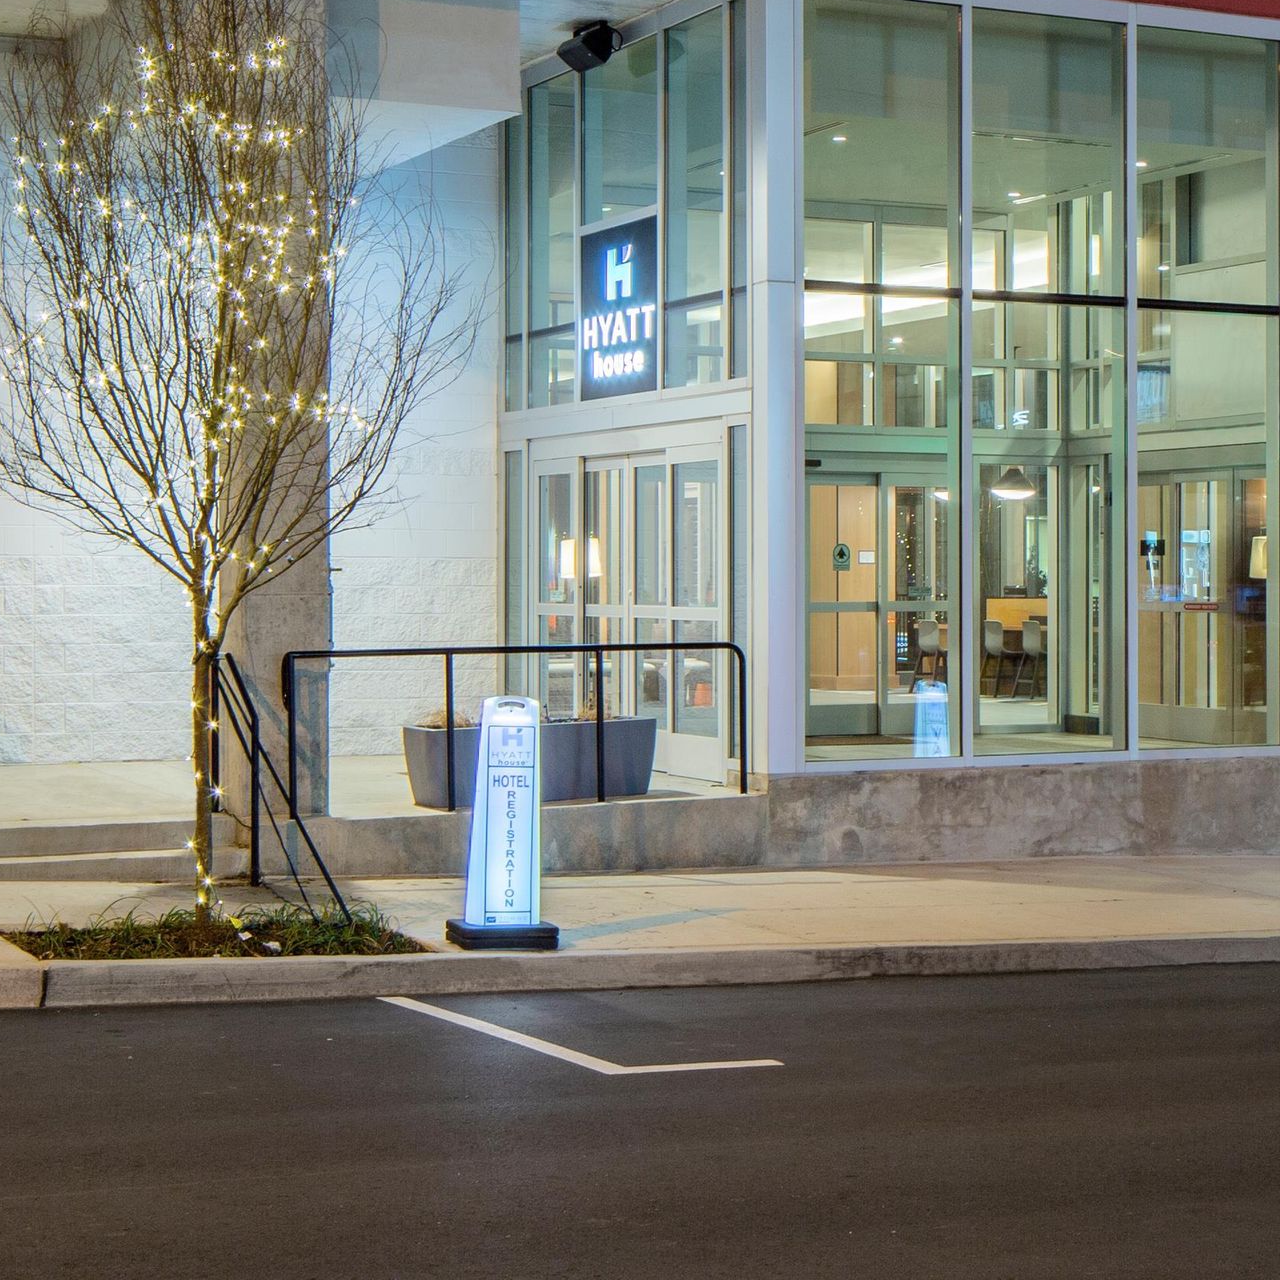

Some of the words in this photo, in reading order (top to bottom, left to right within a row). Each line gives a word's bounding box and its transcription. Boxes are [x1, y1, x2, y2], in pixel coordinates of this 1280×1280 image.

[583, 304, 656, 350] HYATT
[593, 349, 645, 379] house
[491, 751, 532, 759] HYATT
[493, 774, 530, 788] HOTEL
[504, 790, 517, 908] REGISTRATION
